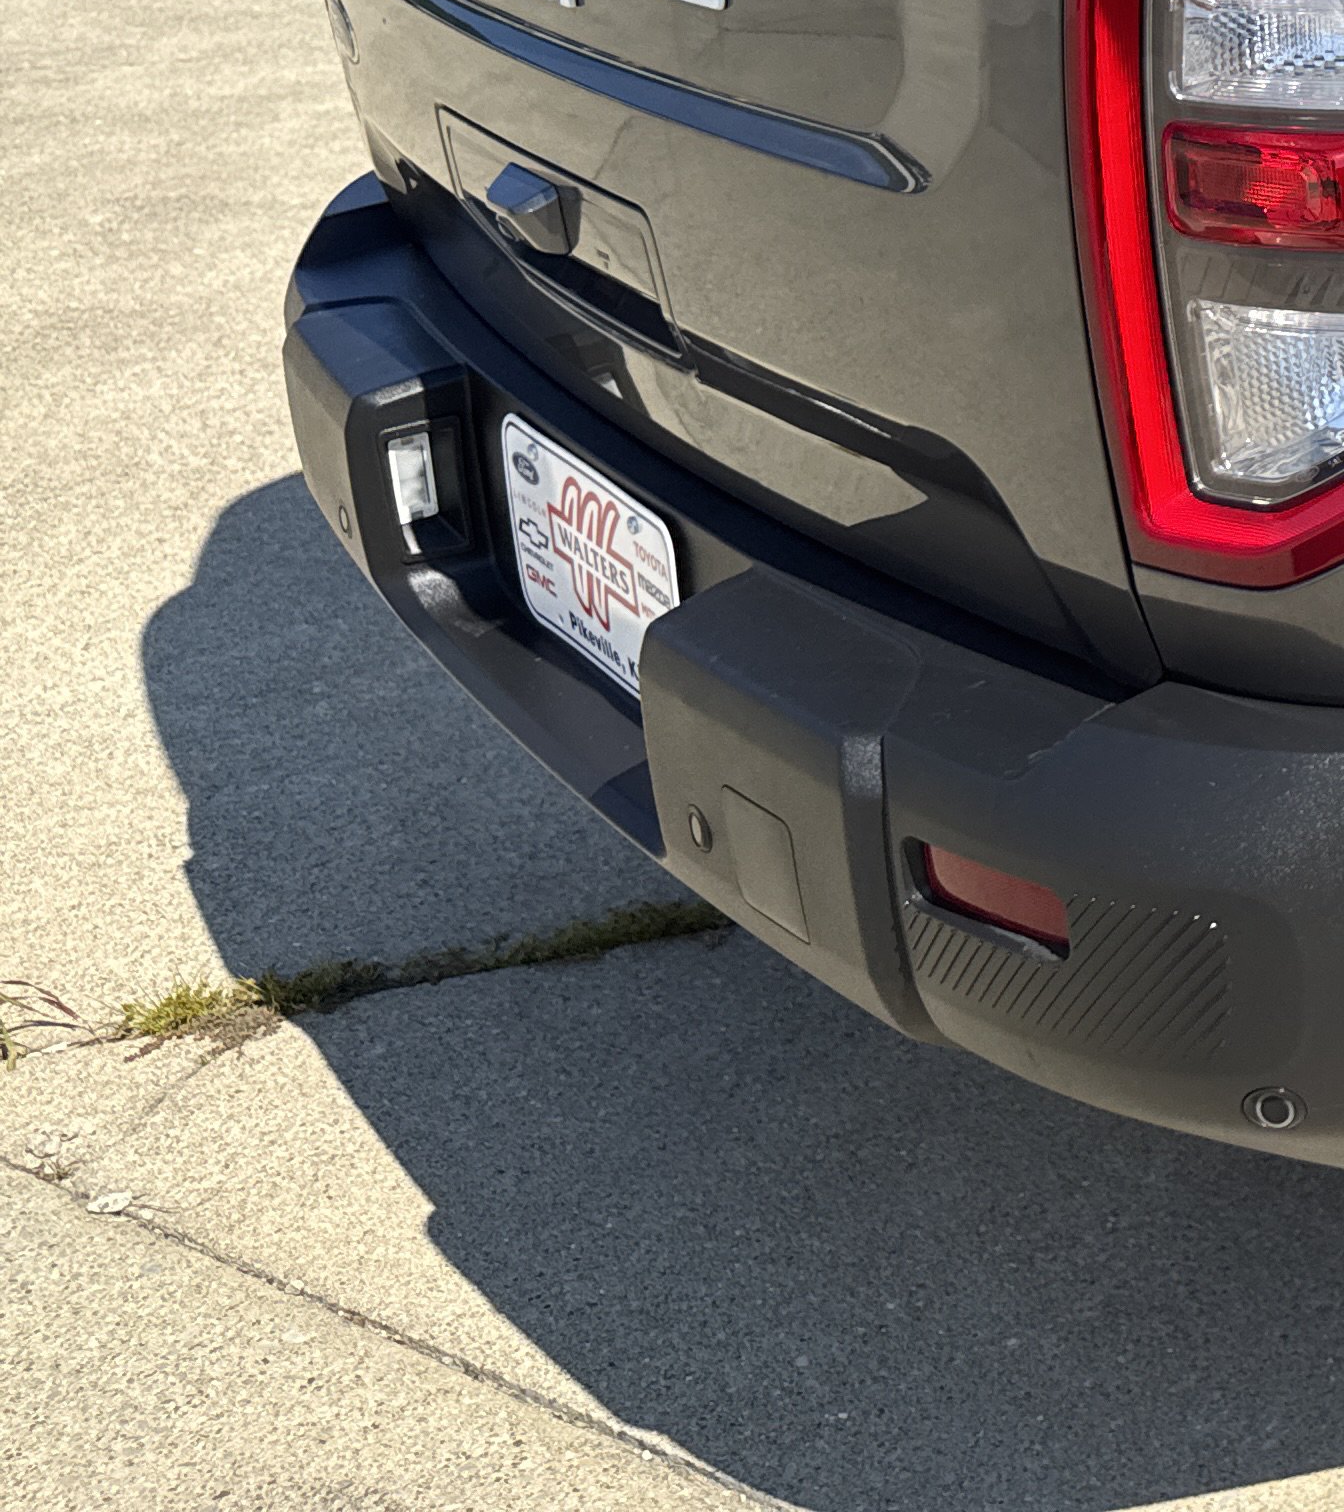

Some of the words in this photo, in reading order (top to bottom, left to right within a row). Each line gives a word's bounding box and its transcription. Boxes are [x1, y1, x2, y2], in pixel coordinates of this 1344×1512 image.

[525, 563, 558, 598] GMC
[557, 522, 630, 595] WALTERS
[633, 540, 669, 582] TOYOTA
[569, 609, 626, 675] Pikeville,
[627, 657, 640, 681] K
